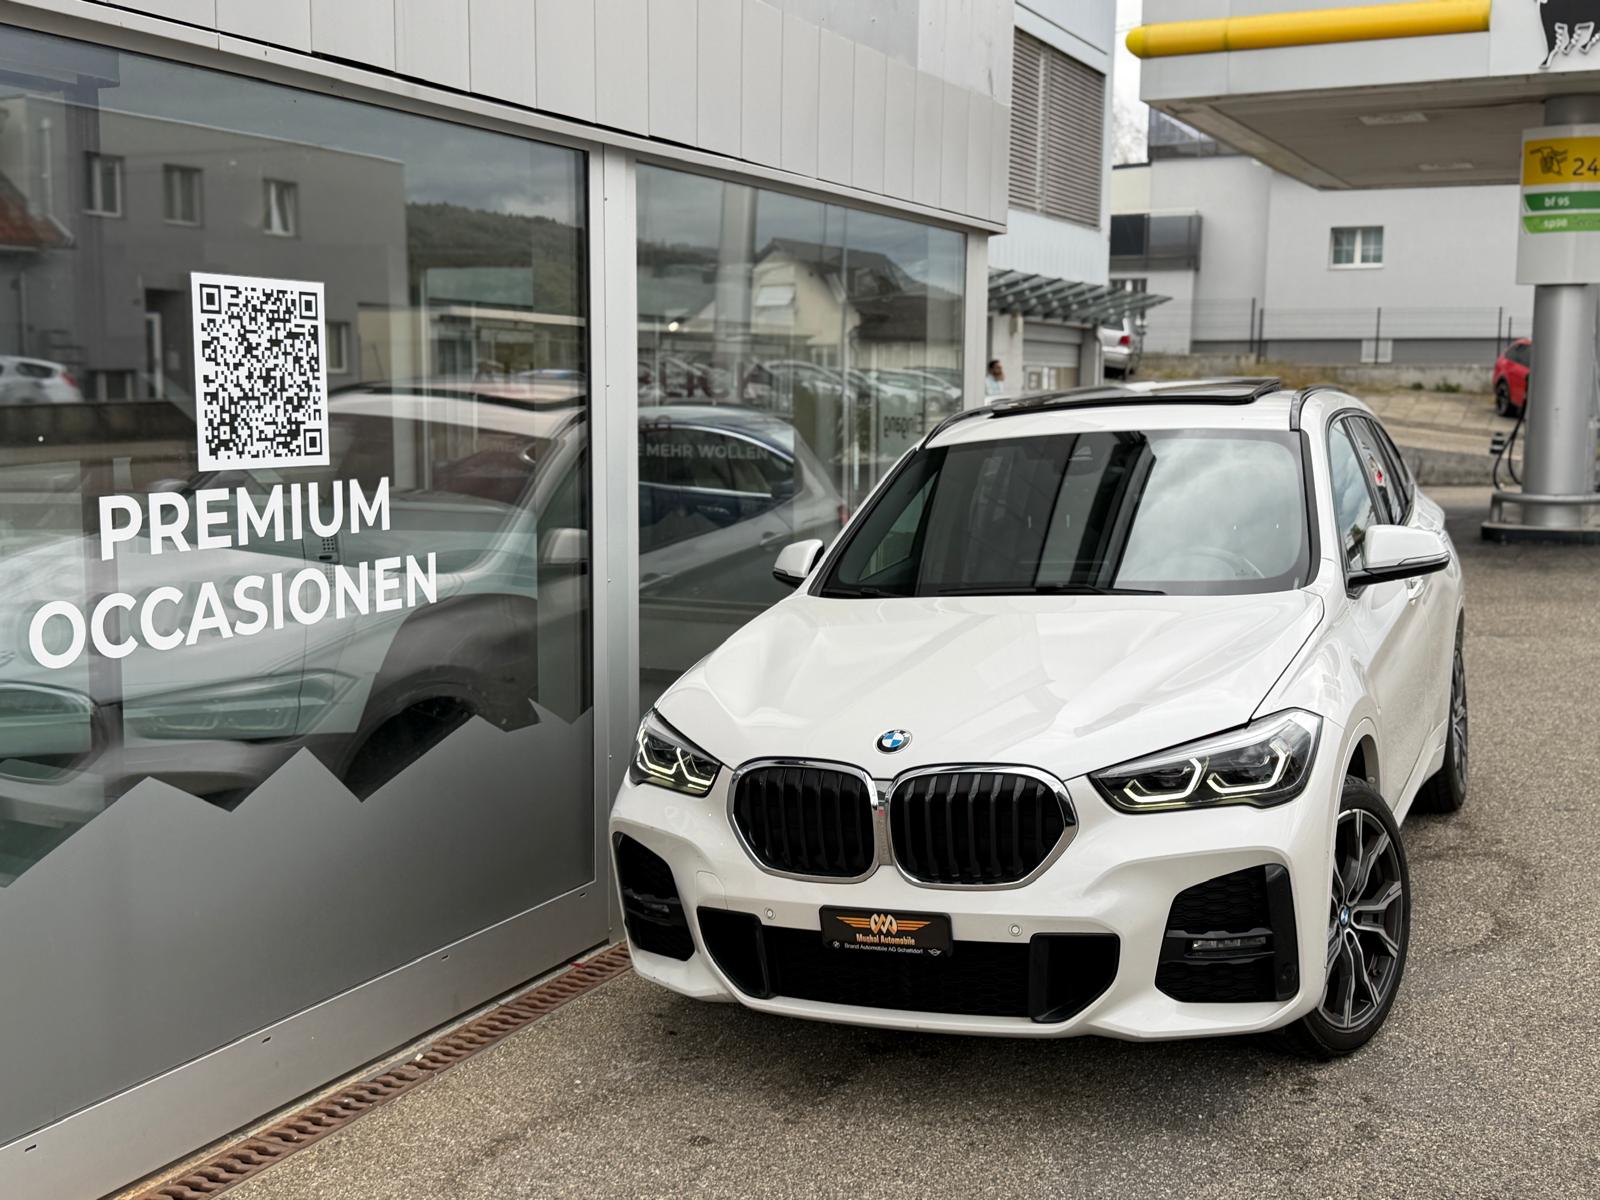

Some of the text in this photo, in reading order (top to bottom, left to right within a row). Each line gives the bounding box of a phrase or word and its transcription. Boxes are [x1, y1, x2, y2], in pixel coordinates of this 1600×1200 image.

[646, 443, 692, 458] MEHR
[697, 444, 768, 460] WOLLEN
[98, 476, 391, 561] PREMIUM
[28, 552, 438, 669] OCCASIONEN
[880, 935, 915, 945] Automobile
